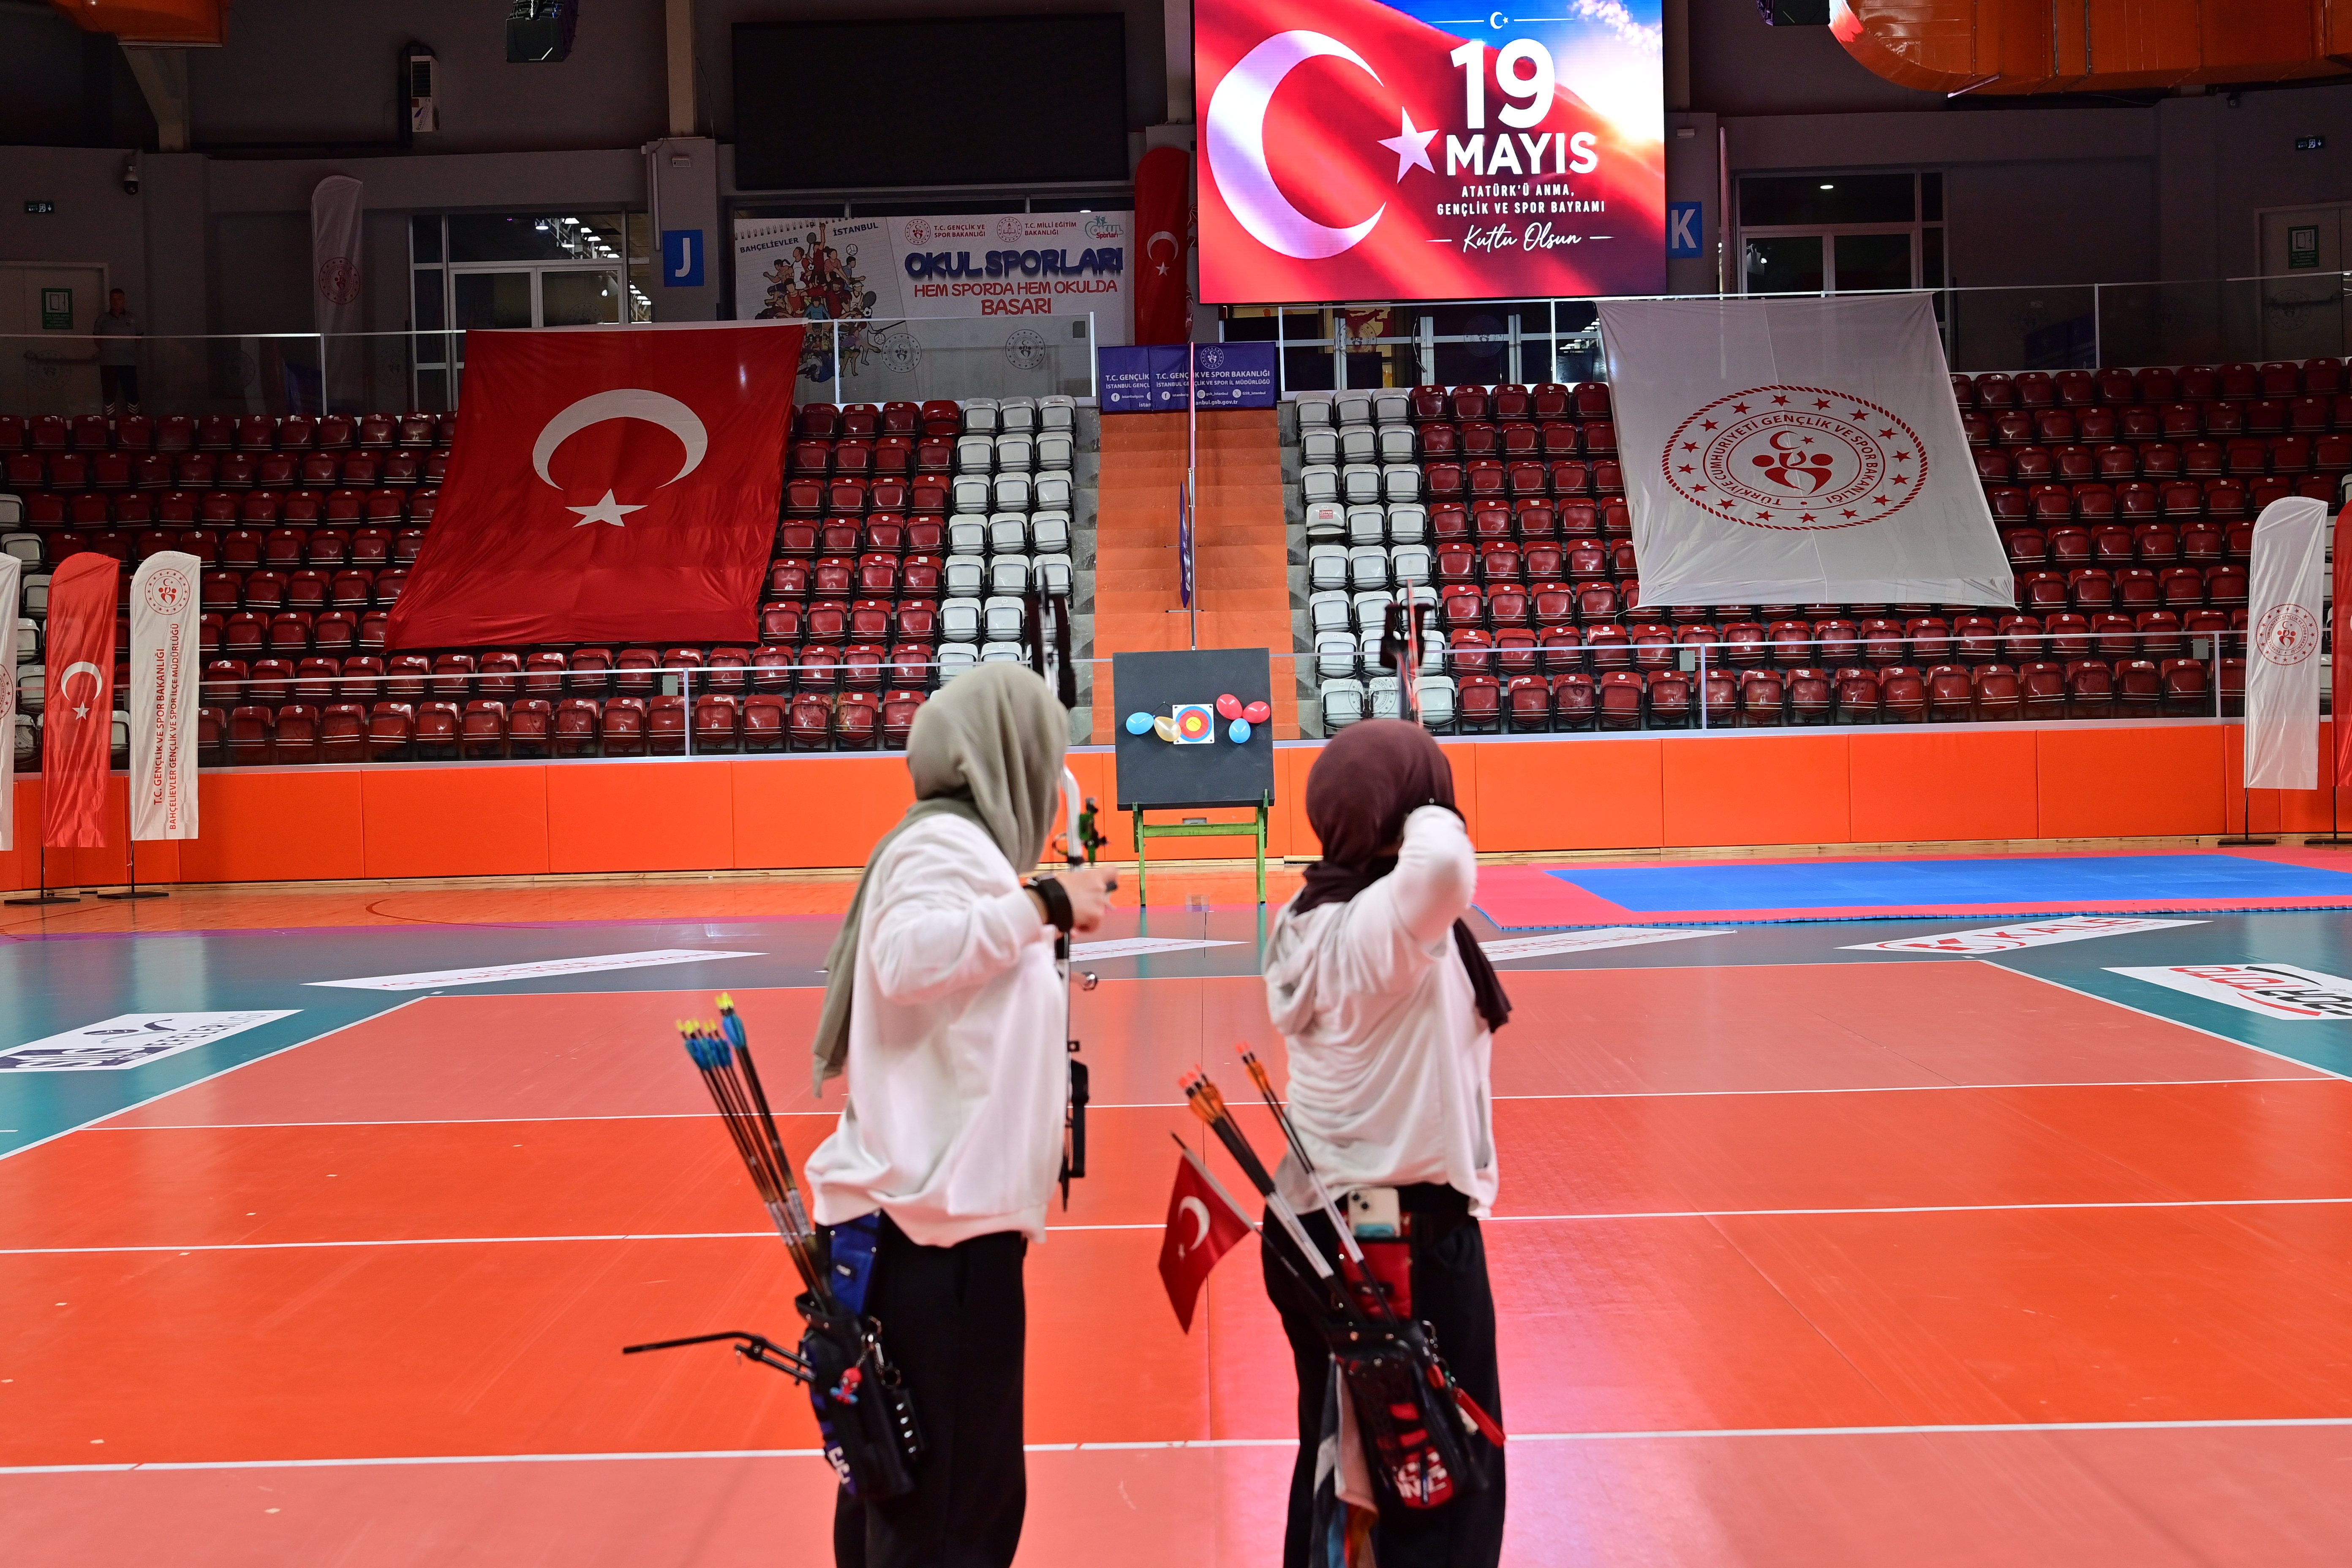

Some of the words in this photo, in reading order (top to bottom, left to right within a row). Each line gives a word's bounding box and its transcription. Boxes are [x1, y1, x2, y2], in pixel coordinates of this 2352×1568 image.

[1450, 38, 1556, 129] 19
[1446, 132, 1598, 177] MAYIS
[1462, 184, 1529, 198] ATATÜRK'Ü
[1536, 183, 1575, 198] ANMA,
[1437, 200, 1488, 218] GENÇLİK
[1494, 202, 1510, 215] VE
[1514, 201, 1546, 215] SPOR
[1551, 201, 1606, 213] BAYRAMI
[832, 222, 878, 237] İSTANBUL
[1462, 225, 1518, 253] Kutlu
[1523, 222, 1582, 251] Olsun
[1671, 209, 1696, 249] K
[739, 237, 799, 253] BAHÇELİEVLER
[675, 237, 690, 278] J
[904, 251, 983, 280] OKUL
[985, 248, 1123, 278] SPORLARI
[915, 284, 948, 297] HEM
[952, 283, 1014, 297] SPORDA
[1017, 282, 1051, 294] HEM
[1054, 280, 1117, 294] OKULDA
[1119, 372, 1149, 382] GENÇLİK
[1156, 380, 1181, 388] İSTANBUL
[1183, 380, 1205, 388] GEÇLİK
[1170, 371, 1200, 381] GENÇK
[1231, 369, 1270, 378] BAKANLIĞI
[1761, 414, 1831, 429] GENÇLİK
[1834, 424, 1853, 437] VE
[1710, 420, 1759, 480] CUMHURİYETİ
[1850, 435, 1877, 460] SPOR
[1721, 480, 1782, 506] TÜRKİYE
[1826, 461, 1878, 503] BAKANLIĞI
[171, 623, 180, 677] MÜDÜRLÜĞÜ
[155, 649, 165, 702] BAKANLIĞI
[171, 679, 180, 696] İLÇE
[156, 704, 164, 728] SPOR
[170, 722, 177, 732] VE
[155, 730, 163, 743] VE
[168, 734, 179, 769] GENÇLİK
[153, 745, 164, 786] GENÇLİK
[154, 788, 163, 806] T.C.
[168, 770, 178, 830] BAHÇELİEVLER
[1974, 918, 2143, 939] KALE
